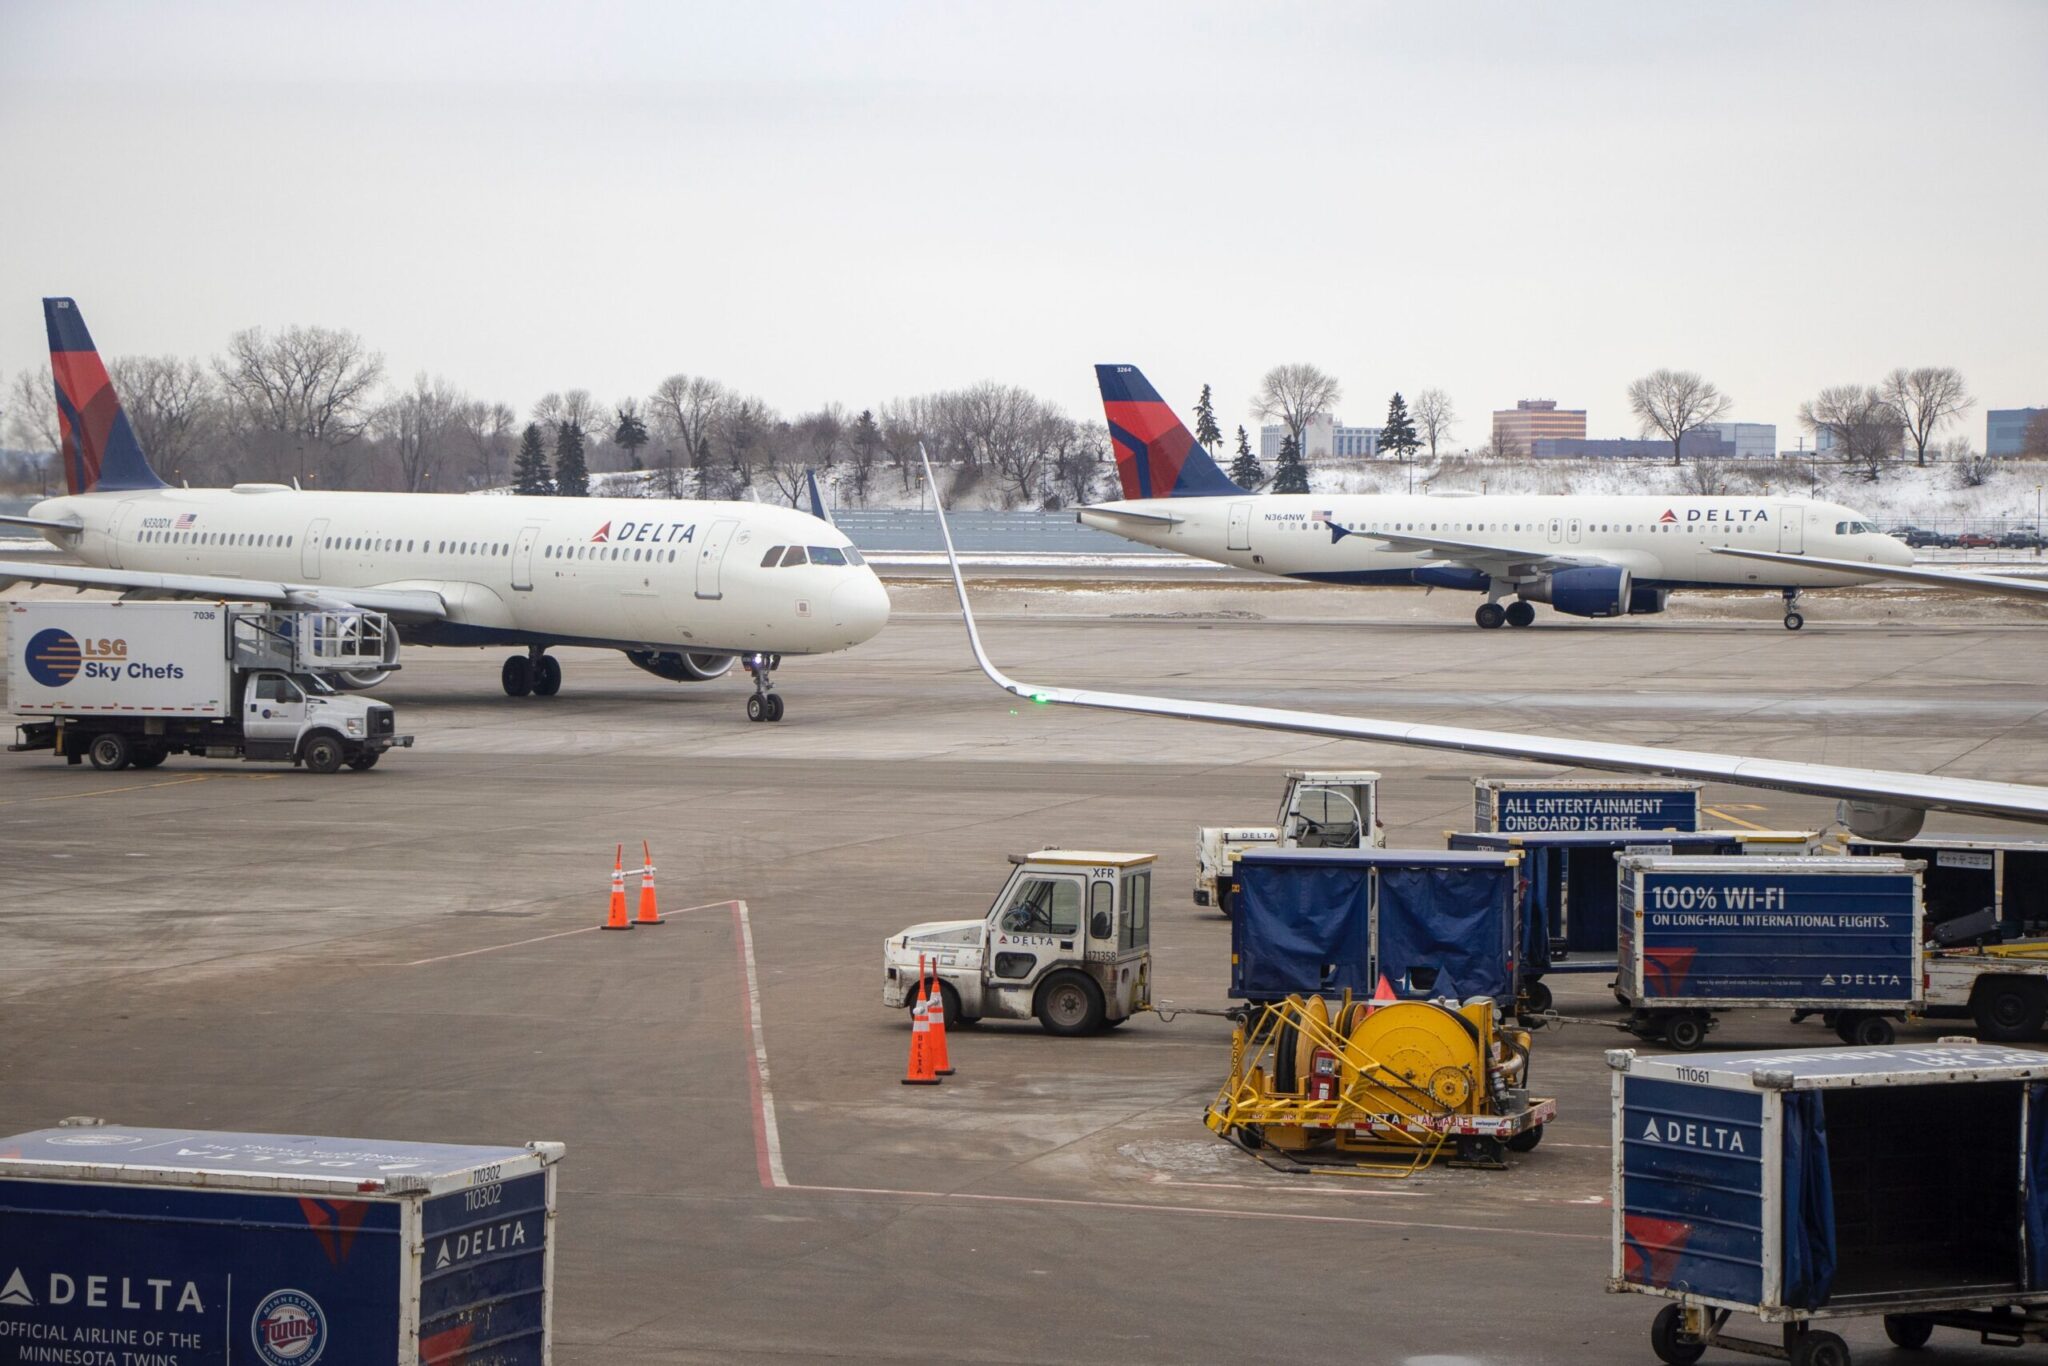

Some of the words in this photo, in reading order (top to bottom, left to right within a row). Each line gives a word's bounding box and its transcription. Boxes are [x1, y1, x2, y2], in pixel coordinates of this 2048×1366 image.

[1264, 513, 1305, 521] N364NW
[1687, 509, 1769, 522] DELTA
[617, 522, 696, 544] DELTA
[193, 611, 216, 620] 7036
[85, 638, 127, 656] LSG
[85, 662, 121, 681] Sky
[127, 663, 184, 679] Chefs
[1505, 798, 1532, 814] ALL
[1536, 798, 1663, 814] ENTERTAINMENT
[1505, 815, 1580, 831] ONBOARD
[1584, 816, 1599, 831] IS
[1603, 816, 1642, 831] FREE.
[1092, 868, 1114, 879] XFR
[1652, 886, 1717, 909] 100%
[1723, 886, 1785, 910] WI-FI
[1652, 914, 1670, 925] ON
[1673, 914, 1740, 926] LONG-HAUL
[1743, 914, 1836, 927] INTERNATIONAL
[1839, 916, 1890, 928] FLIGHTS.
[1012, 936, 1054, 946] DELTA
[1087, 950, 1117, 962] 171358
[1841, 974, 1901, 986] DELTA
[1676, 1067, 1710, 1084] 111061
[1667, 1121, 1744, 1153] DELTA
[473, 1164, 501, 1185] 110302
[465, 1183, 502, 1212] 110302
[456, 1220, 526, 1260] DELTA
[49, 1272, 205, 1314] DELTA
[263, 1296, 316, 1318] MINNESOTA
[0, 1320, 68, 1341] OFFICIAL
[73, 1327, 138, 1345] AIRLINE
[143, 1331, 164, 1347] OF
[169, 1332, 201, 1349] THE
[259, 1315, 318, 1346] Twins
[19, 1345, 116, 1366] MINNESOTA
[122, 1352, 178, 1366] TWINS
